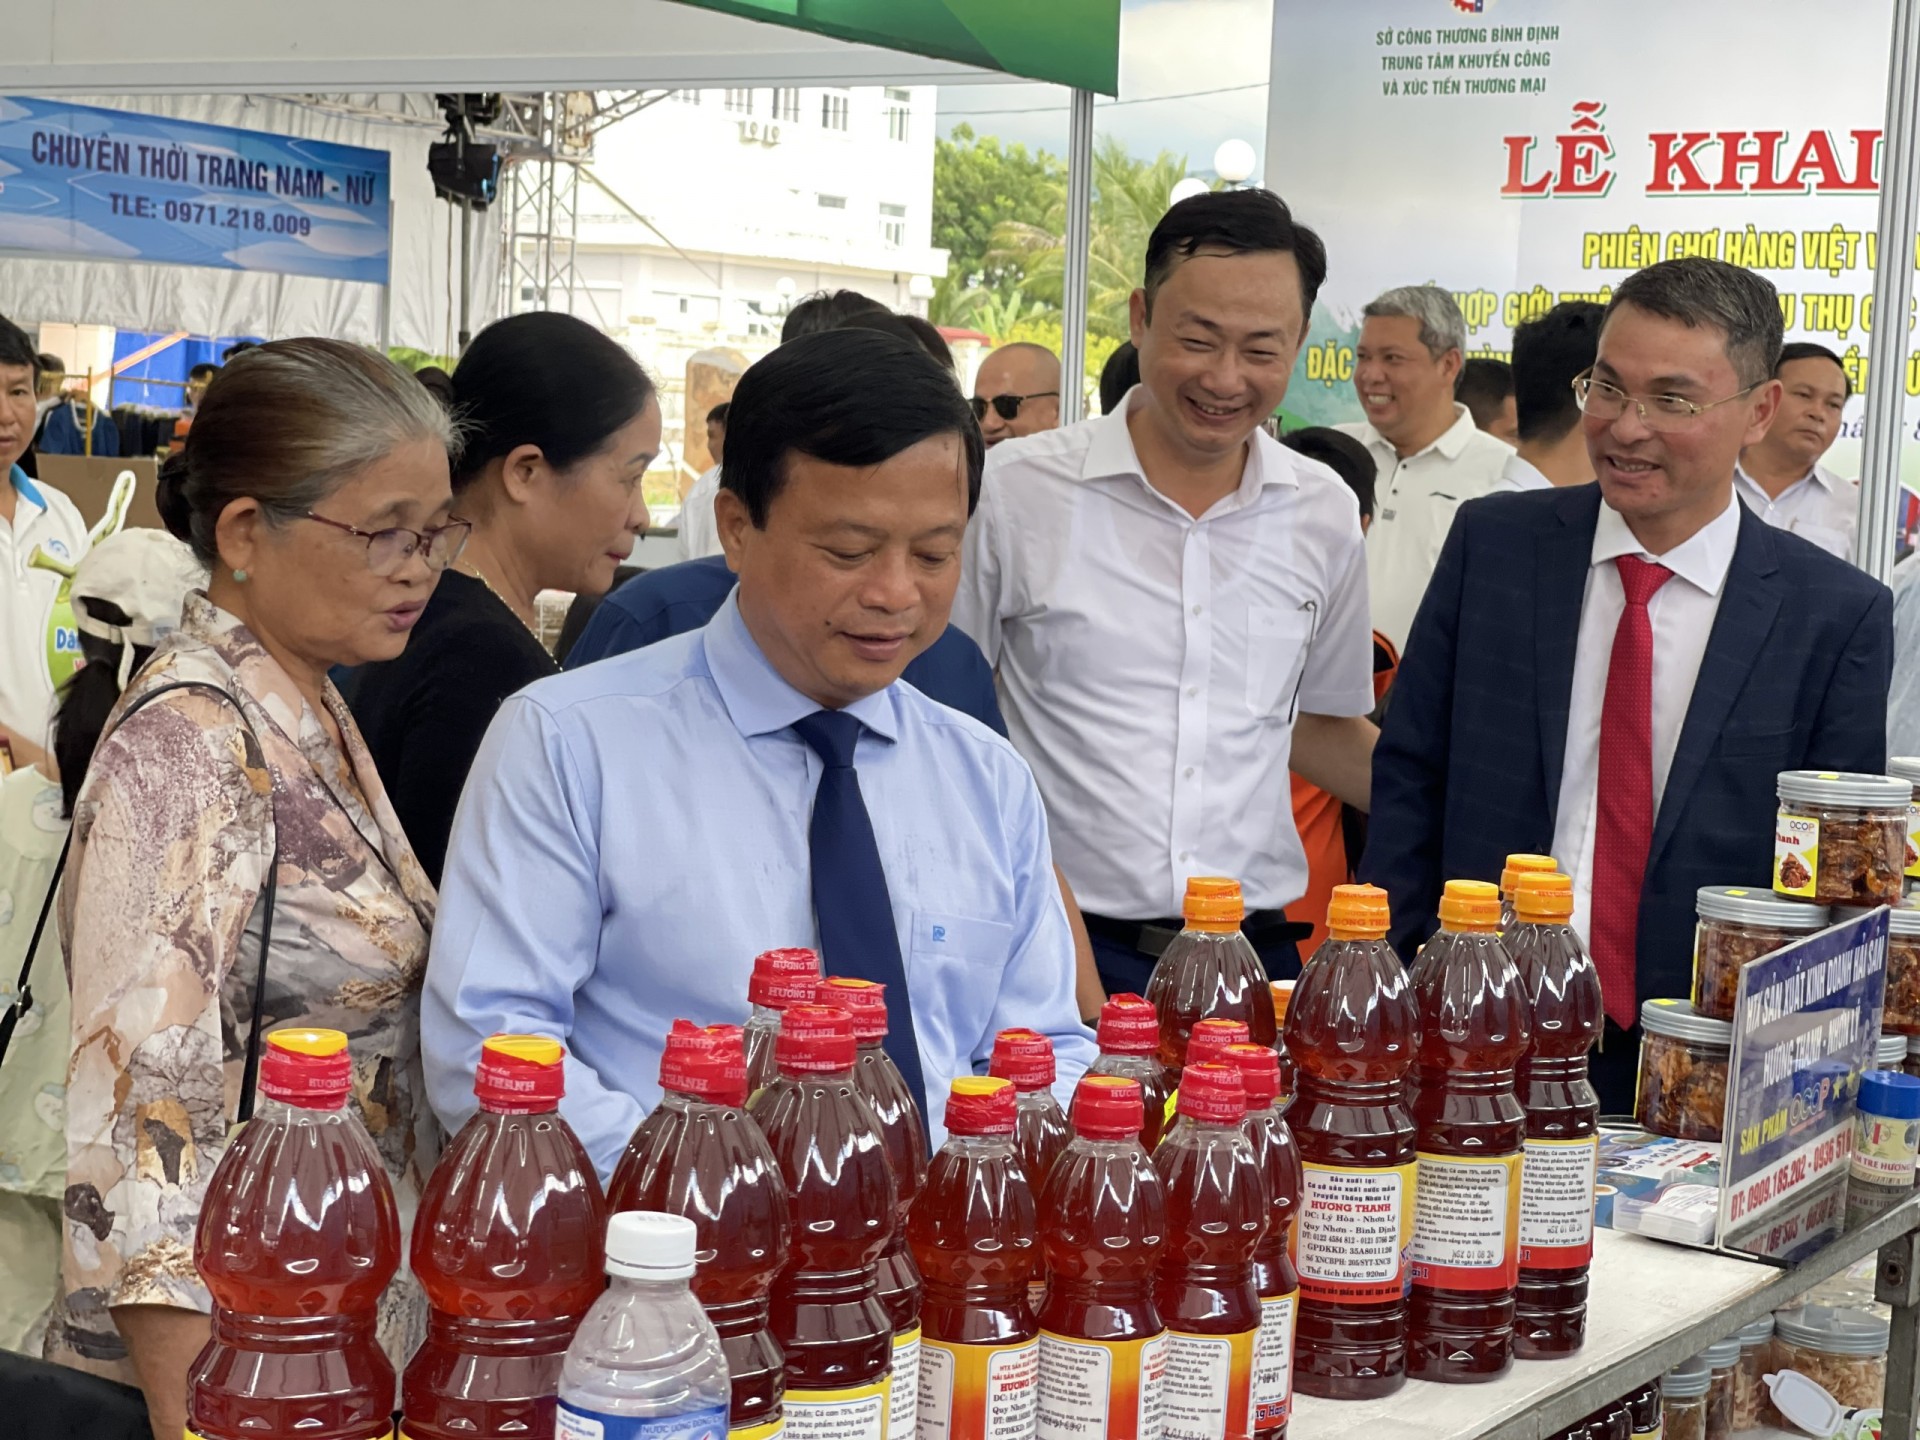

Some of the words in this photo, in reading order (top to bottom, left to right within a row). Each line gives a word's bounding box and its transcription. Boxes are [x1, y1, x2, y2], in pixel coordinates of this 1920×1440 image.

[1376, 26, 1393, 46] SỞ
[1397, 29, 1431, 45] CÔNG
[1436, 28, 1487, 44] THƯƠNG
[1491, 25, 1522, 43] BÌNH
[1527, 26, 1559, 44] ĐỊNH
[1381, 56, 1422, 70] TRUNG
[1427, 54, 1454, 69] TÂM
[1458, 49, 1510, 68] KHUYẾN
[1514, 49, 1550, 67] CÔNG
[1383, 78, 1398, 95] VÀ
[1402, 78, 1428, 95] XÚC
[1433, 75, 1460, 95] TIẾN
[1465, 77, 1516, 94] THƯƠNG
[1520, 78, 1546, 95] MẠI
[32, 132, 129, 174] CHUYÊN
[138, 142, 188, 182] THỜI
[196, 153, 268, 192] TRANG
[276, 165, 324, 199] NAM
[346, 171, 375, 206] NỮ
[1501, 101, 1616, 199] LỄ
[1646, 128, 1884, 198] KHAI
[109, 193, 157, 218] TLE:
[165, 201, 310, 236] 0971.218.009
[1582, 225, 1660, 269] PHIÊN
[1725, 224, 1796, 269] HÀNG
[1802, 224, 1860, 276] VIỆT
[1802, 293, 1854, 339] THỤ
[1307, 340, 1352, 388] ĐẶC
[1790, 821, 1814, 832] OCOP
[1762, 972, 1783, 1025] SẢN
[1783, 959, 1805, 1017] XUẤT
[1806, 962, 1826, 1006] KINH
[1827, 949, 1853, 996] DOANH
[1868, 926, 1884, 975] SẢN
[1795, 1025, 1822, 1072] THANH
[1747, 1155, 1807, 1212] 0909.185.202
[1304, 1221, 1320, 1232] Quy
[1323, 1224, 1347, 1233] Nhơn
[1311, 1200, 1352, 1212] HƯƠNG
[1355, 1204, 1391, 1212] THANH
[1321, 1213, 1332, 1222] Lý
[1363, 1215, 1384, 1223] Nhơn
[1387, 1214, 1396, 1222] Lý
[1324, 1269, 1340, 1277] tích
